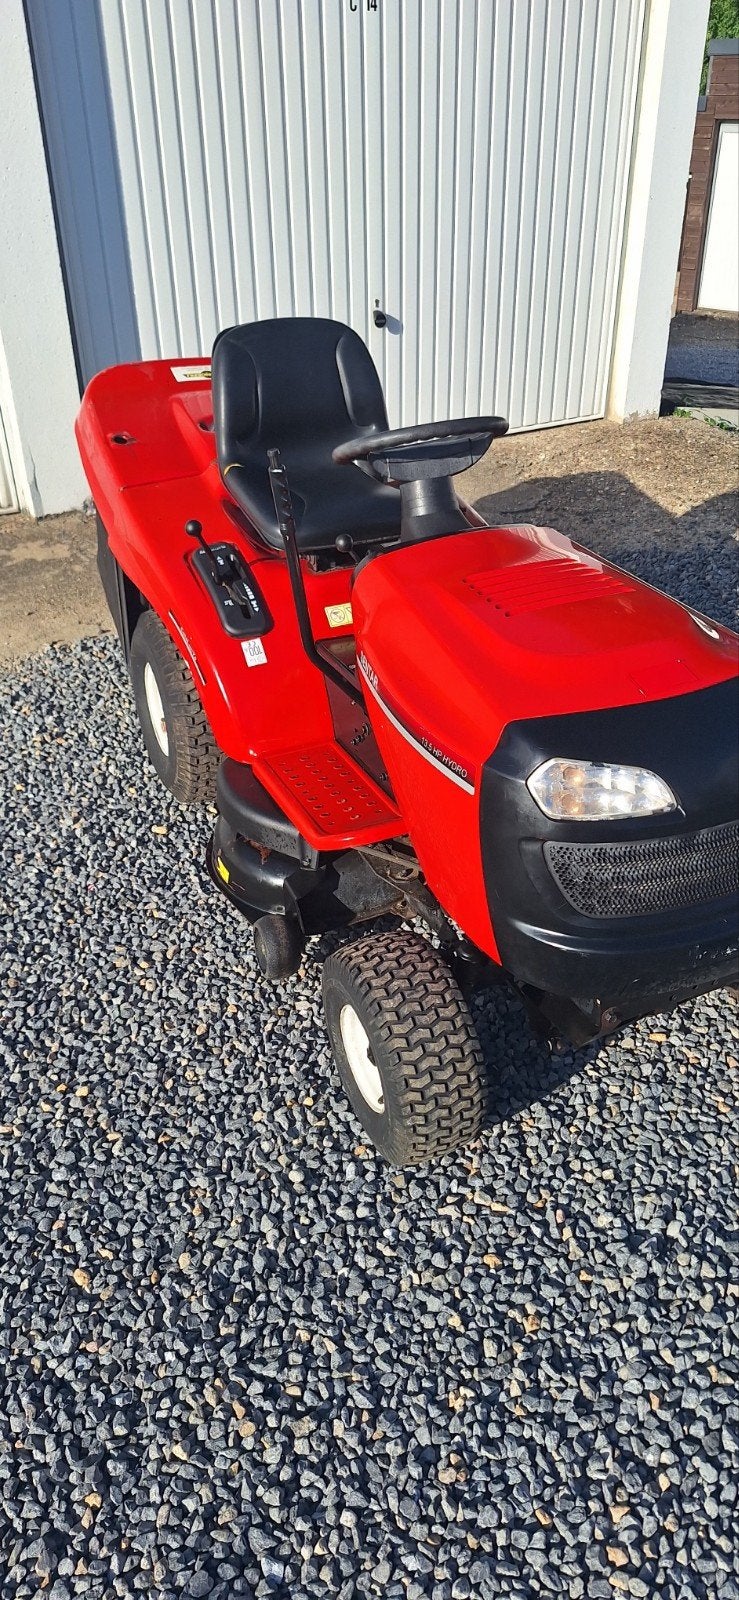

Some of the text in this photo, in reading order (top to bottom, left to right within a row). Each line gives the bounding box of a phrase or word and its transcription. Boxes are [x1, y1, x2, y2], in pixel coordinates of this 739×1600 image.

[367, 0, 377, 11] 14
[421, 736, 468, 778] 13.5 HP HYDRO
